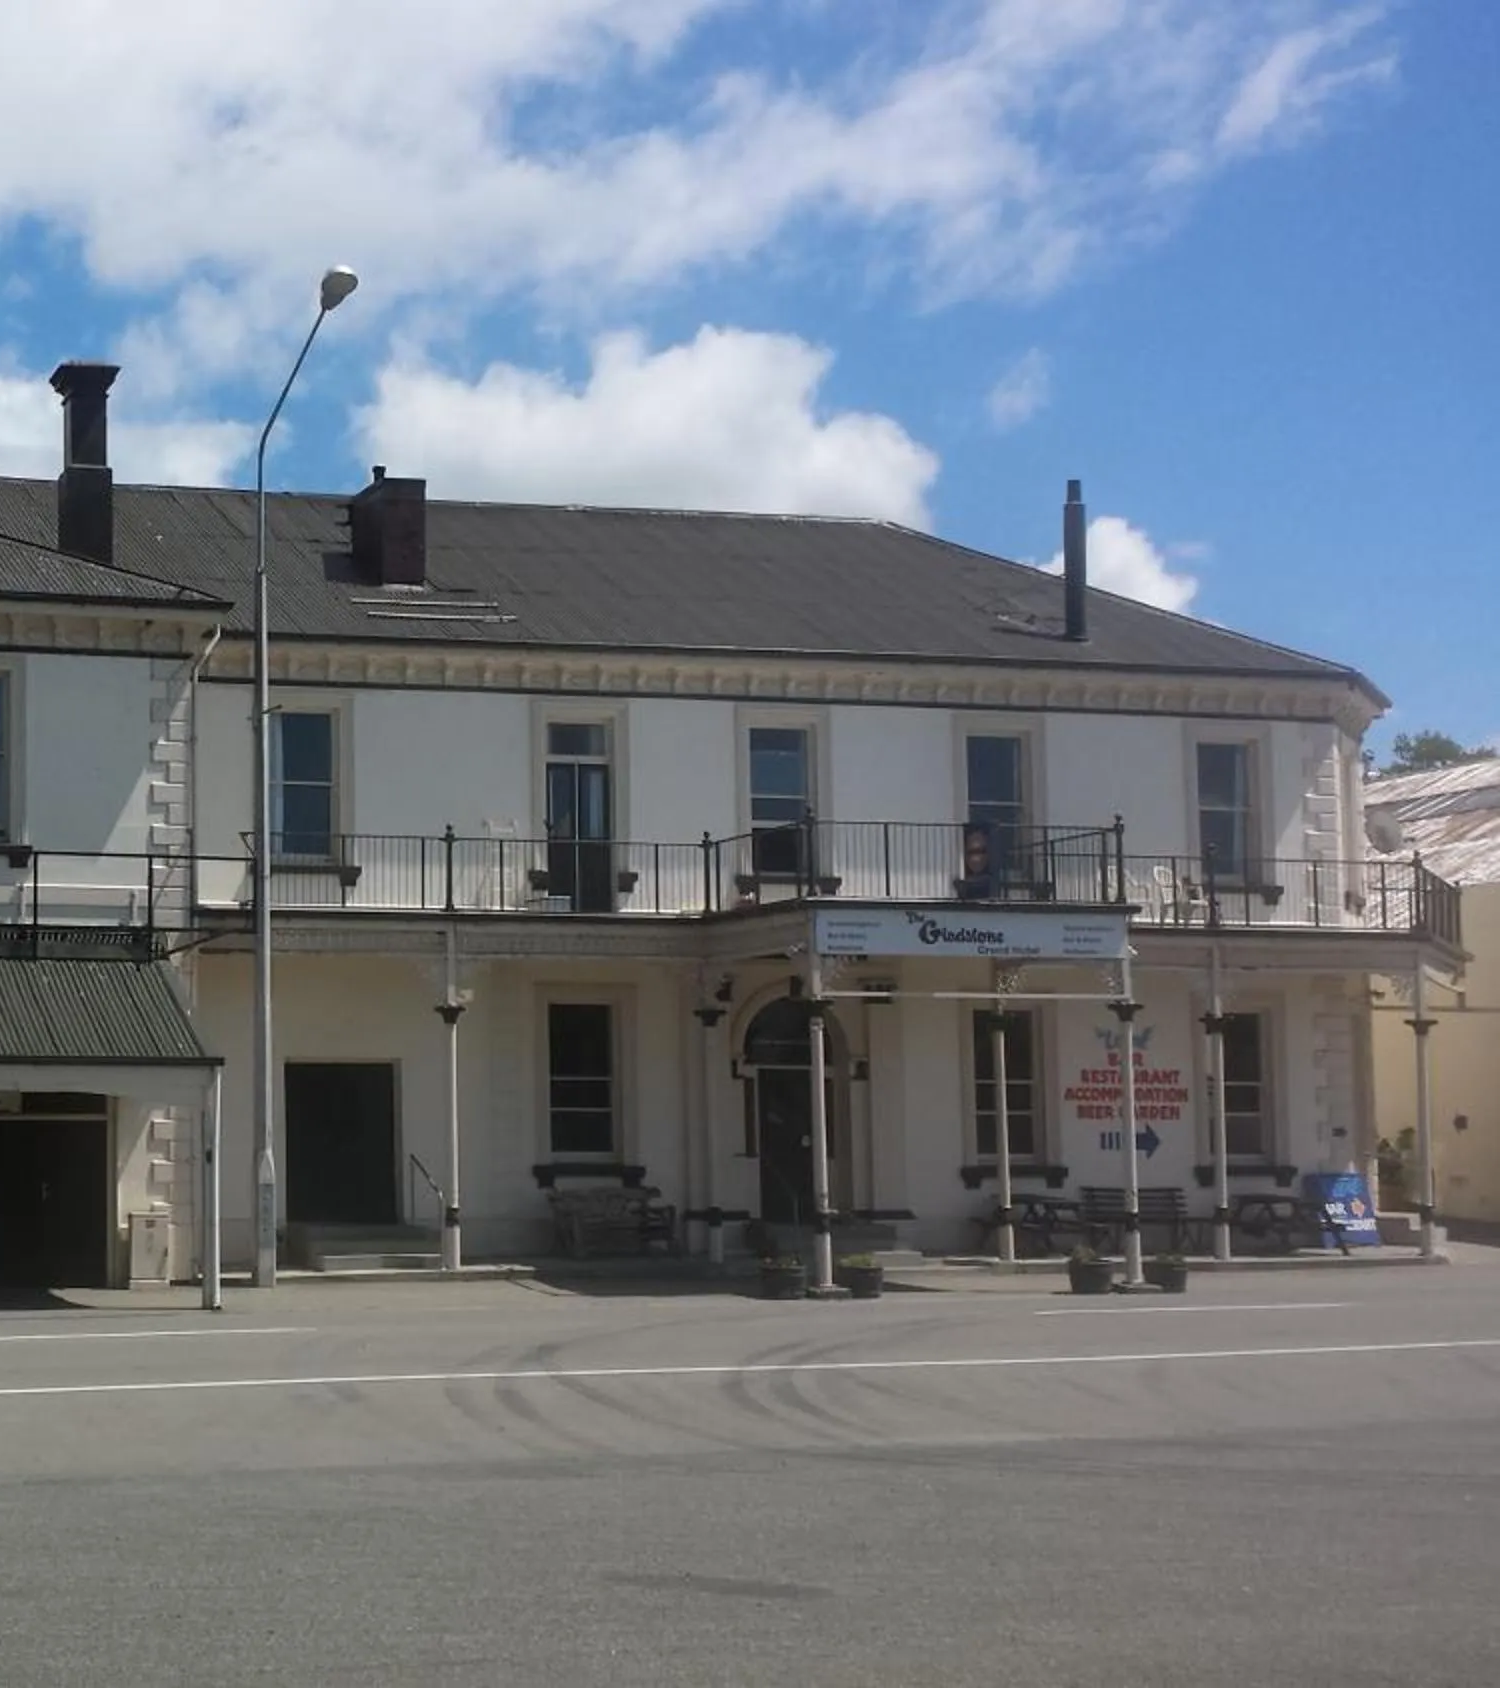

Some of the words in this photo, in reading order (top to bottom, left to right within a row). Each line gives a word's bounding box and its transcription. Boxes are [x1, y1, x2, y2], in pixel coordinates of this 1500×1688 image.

[905, 911, 925, 924] The
[918, 919, 1005, 944] Gladstone
[1107, 1052, 1144, 1067] BR
[1064, 1087, 1189, 1102] ACCOMMDATION
[1076, 1105, 1114, 1120] BEER
